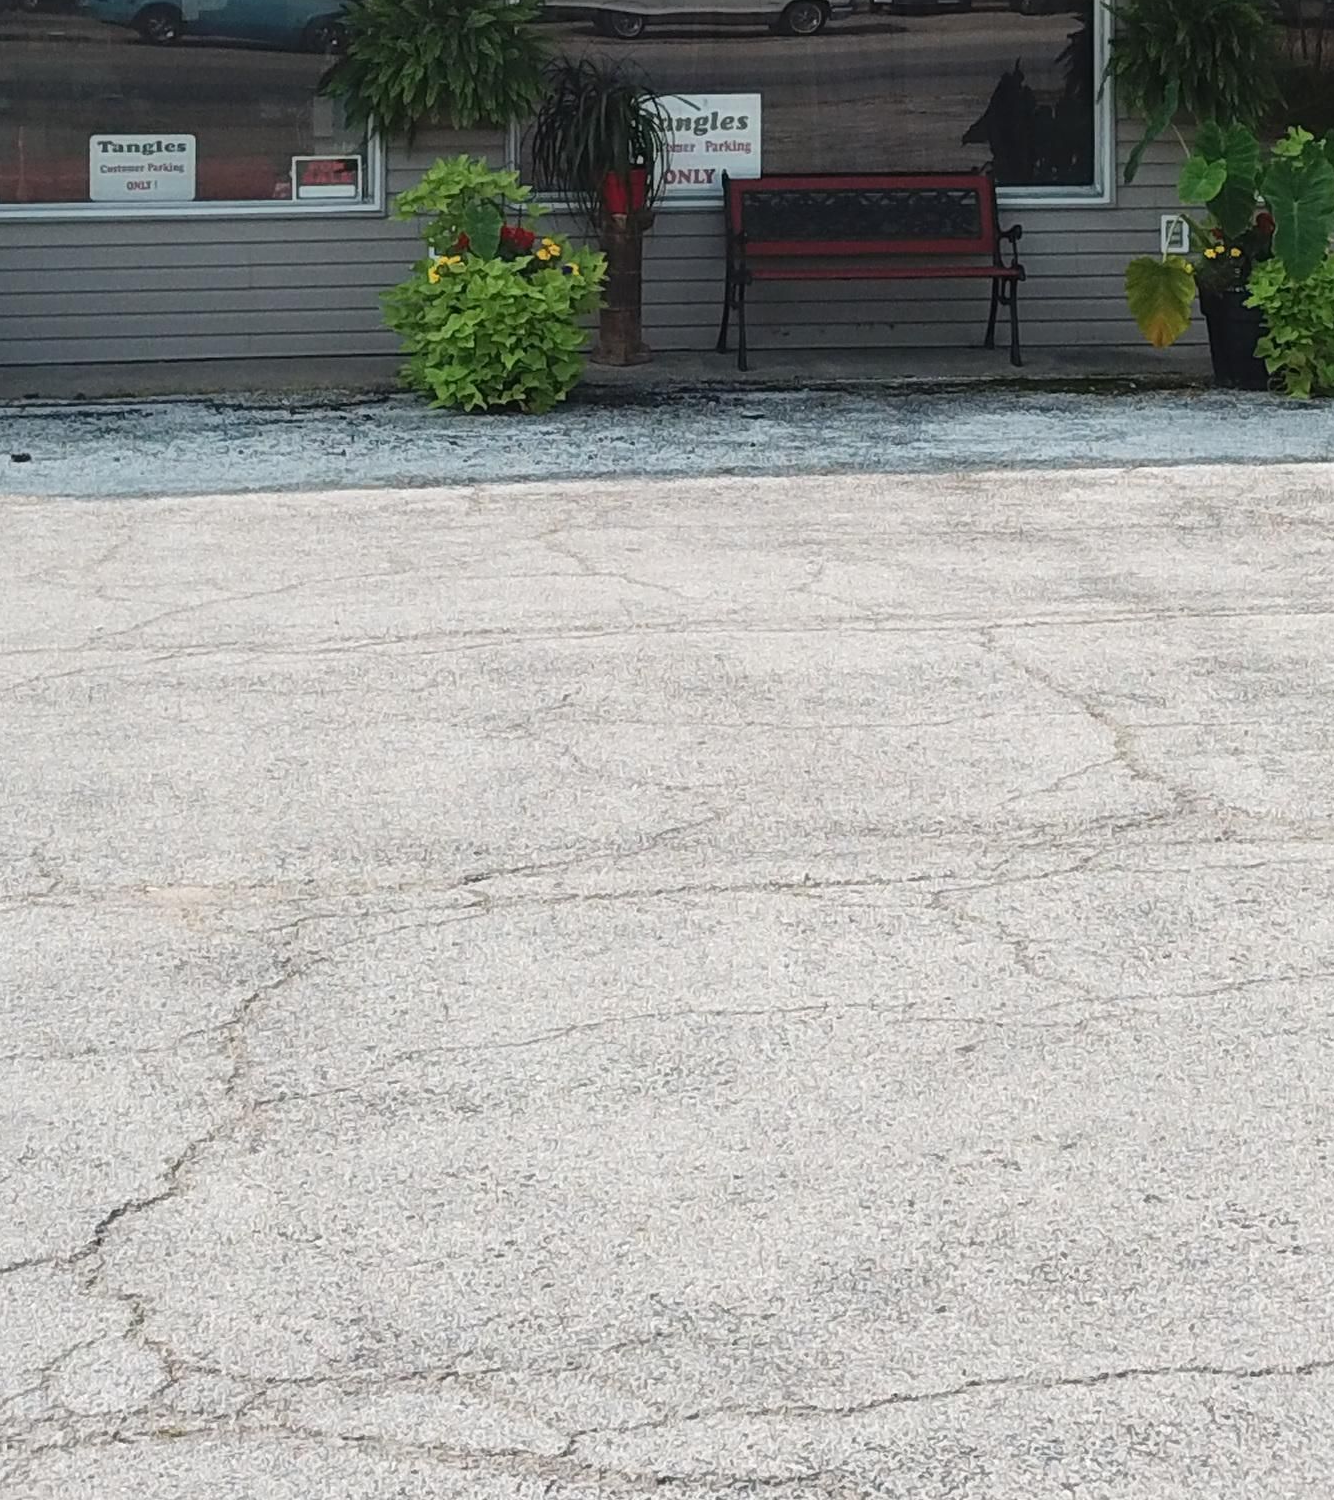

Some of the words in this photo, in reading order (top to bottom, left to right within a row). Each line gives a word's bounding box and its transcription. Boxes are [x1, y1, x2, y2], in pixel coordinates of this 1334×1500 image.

[97, 141, 187, 155] Tangles
[705, 140, 752, 154] Parking
[99, 165, 145, 173] Customer
[147, 163, 185, 173] Parking
[665, 168, 715, 184] ONLY
